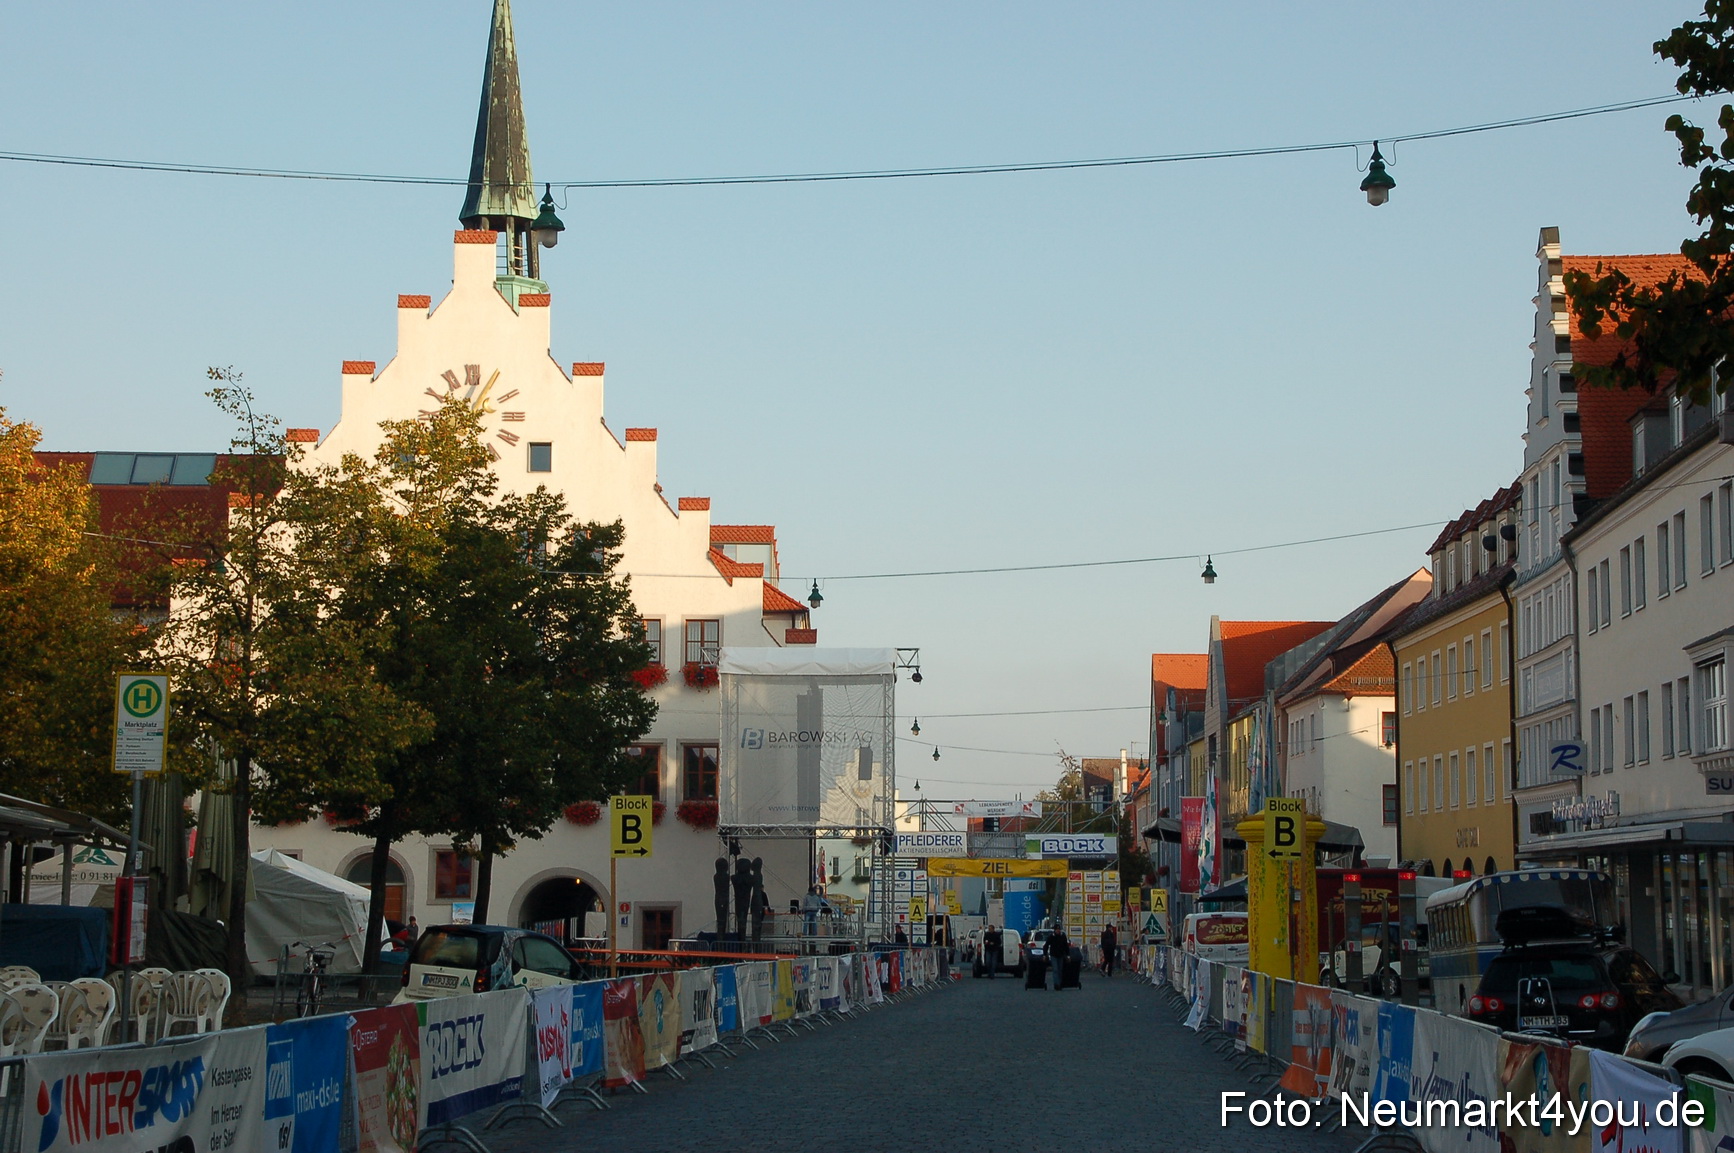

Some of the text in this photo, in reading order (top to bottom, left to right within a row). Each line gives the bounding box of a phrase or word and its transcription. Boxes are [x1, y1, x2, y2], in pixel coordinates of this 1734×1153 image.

[133, 688, 152, 709] H
[768, 731, 846, 743] BAROWSKI
[852, 731, 873, 743] AG
[615, 798, 648, 810] Block
[1269, 800, 1301, 812] Block
[622, 815, 642, 844] B
[1275, 816, 1296, 847] B
[899, 835, 962, 846] PFLEIDERER
[1042, 839, 1105, 853] BOCK
[982, 862, 1013, 874] ZIEL
[88, 872, 99, 880] 91
[103, 873, 113, 881] 81
[1028, 881, 1039, 890] dsl
[1155, 896, 1164, 908] A
[913, 905, 922, 917] A
[1522, 1016, 1534, 1025] NM
[1539, 1016, 1550, 1025] TH
[426, 1014, 485, 1080] BOCK
[211, 1066, 252, 1088] Kastengasse
[65, 1055, 206, 1146] INTERSPORT
[211, 1103, 243, 1126] Im Herzen
[210, 1130, 222, 1151] der
